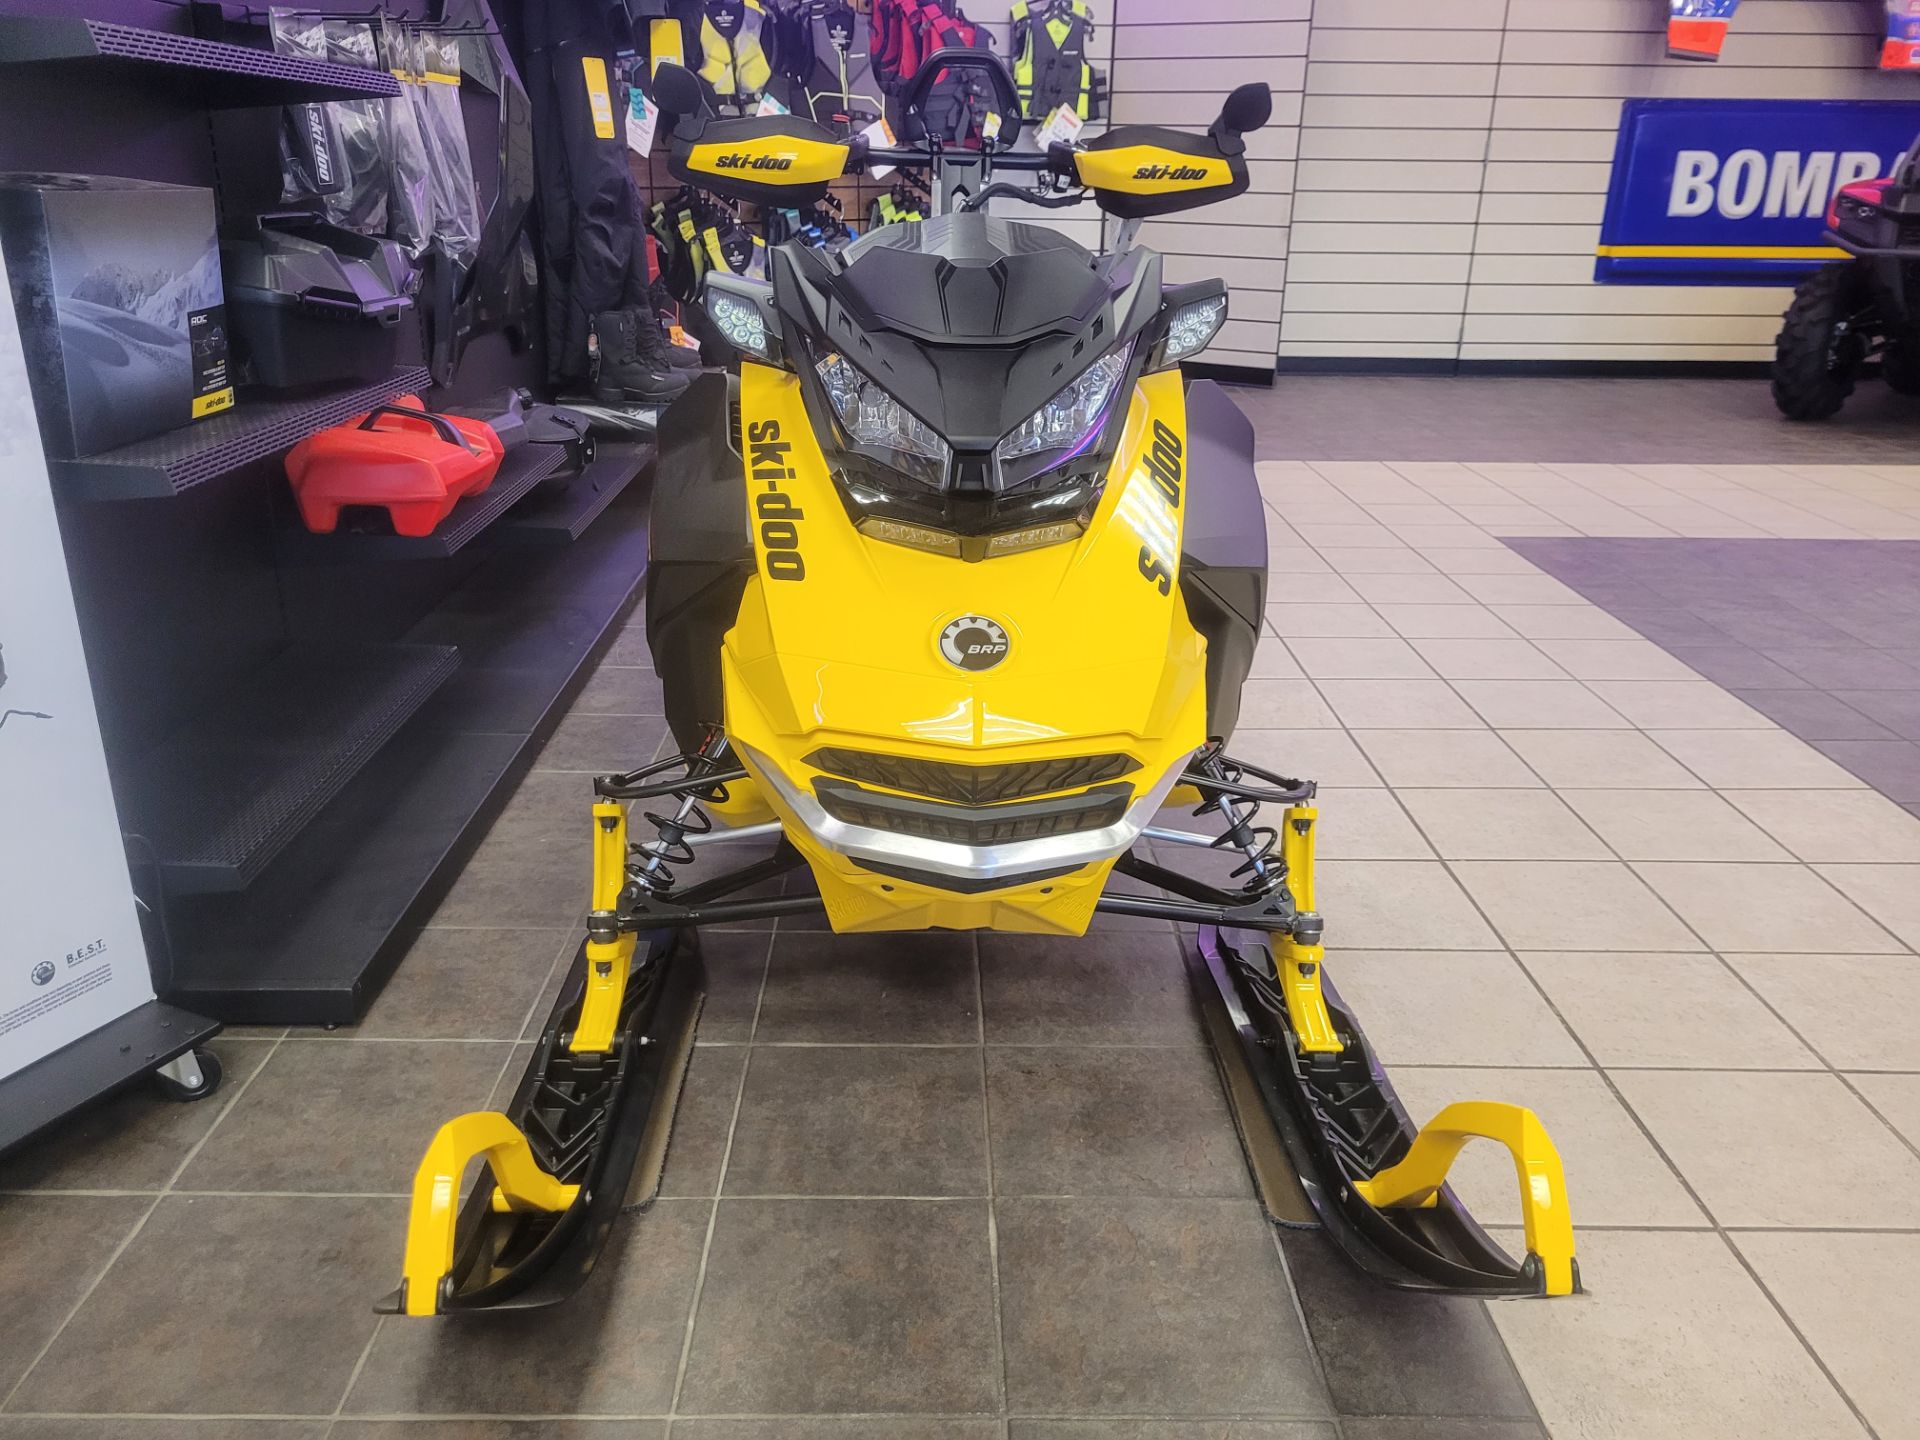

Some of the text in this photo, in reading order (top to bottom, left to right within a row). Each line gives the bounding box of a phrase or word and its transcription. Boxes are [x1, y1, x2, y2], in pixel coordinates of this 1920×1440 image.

[308, 108, 330, 182] ski-doo
[715, 153, 793, 170] ski-doo
[1132, 165, 1208, 180] ski-doo
[1667, 149, 1908, 220] BOMB
[748, 419, 806, 582] ski-doo
[967, 644, 1007, 654] BRP
[66, 939, 106, 965] B.E.S.T.
